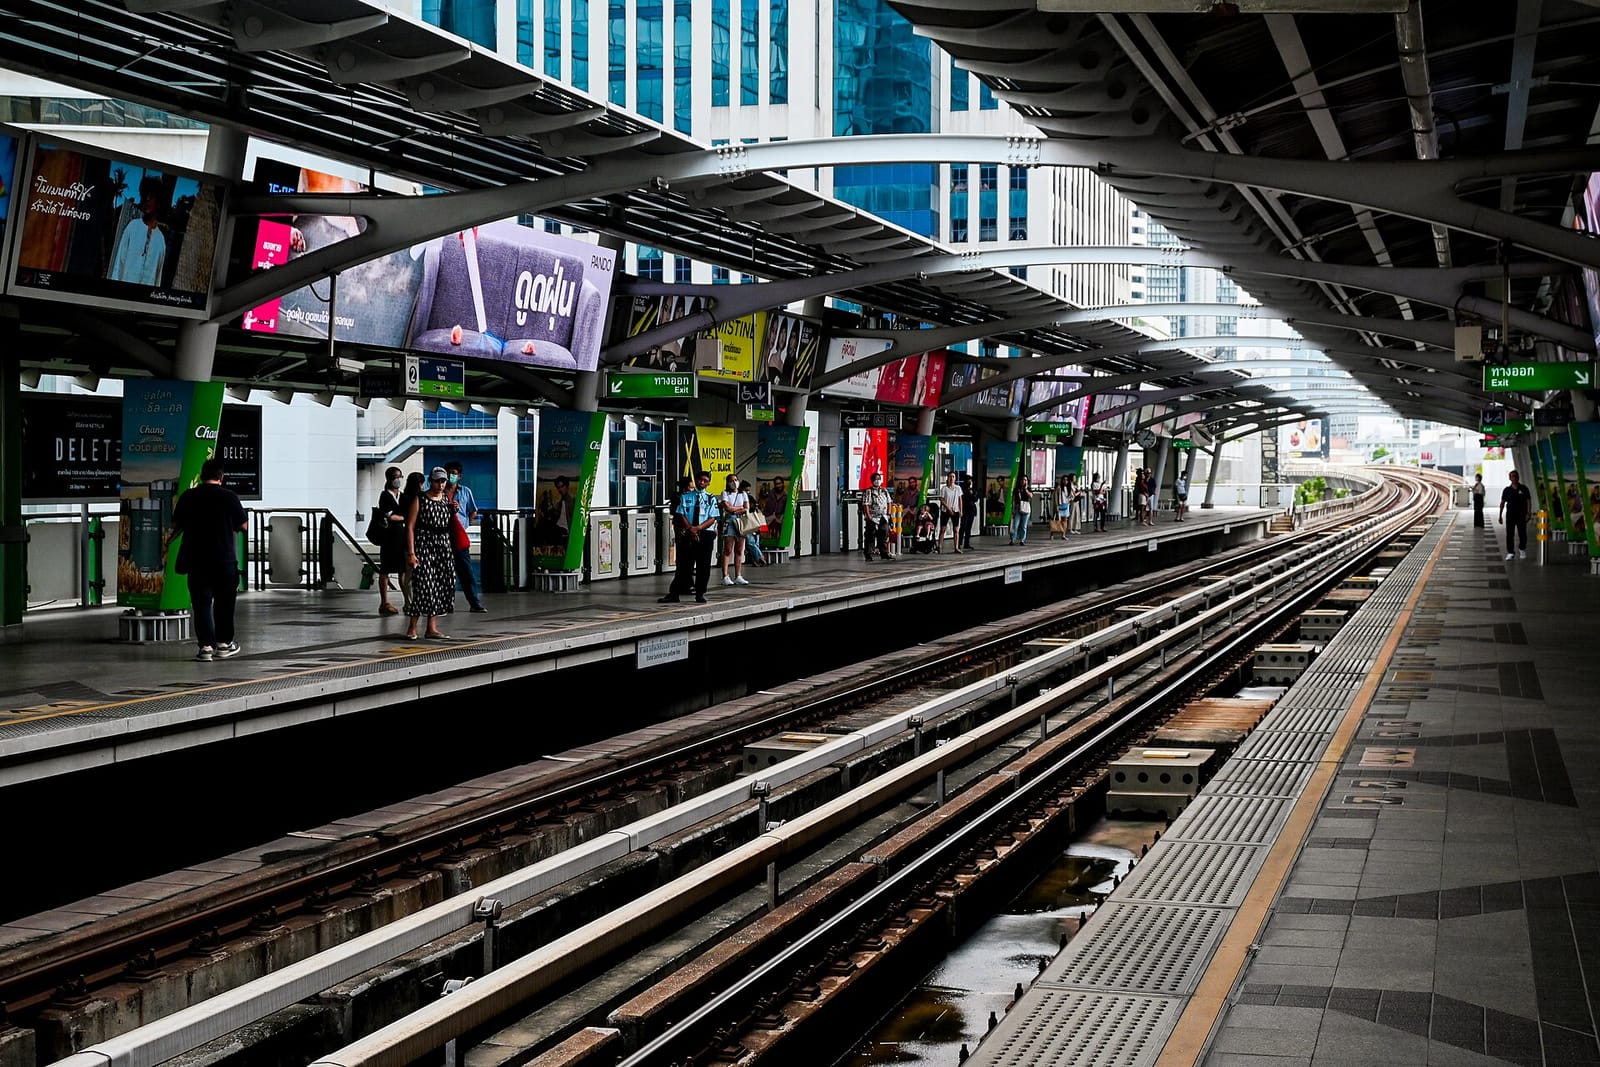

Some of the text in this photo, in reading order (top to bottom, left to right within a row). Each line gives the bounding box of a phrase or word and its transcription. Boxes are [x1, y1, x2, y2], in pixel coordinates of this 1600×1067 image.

[591, 255, 612, 272] PANDO
[515, 258, 576, 331] ดูดฝุ่น
[410, 367, 416, 382] 2
[1491, 366, 1535, 377] ทางออก
[654, 376, 689, 386] ทางออก
[1491, 378, 1509, 387] Exit
[674, 386, 689, 394] Exit
[138, 424, 166, 436] Chang
[223, 446, 255, 460] DELETE
[702, 447, 732, 460] MISTINE
[717, 463, 731, 472] BLACK
